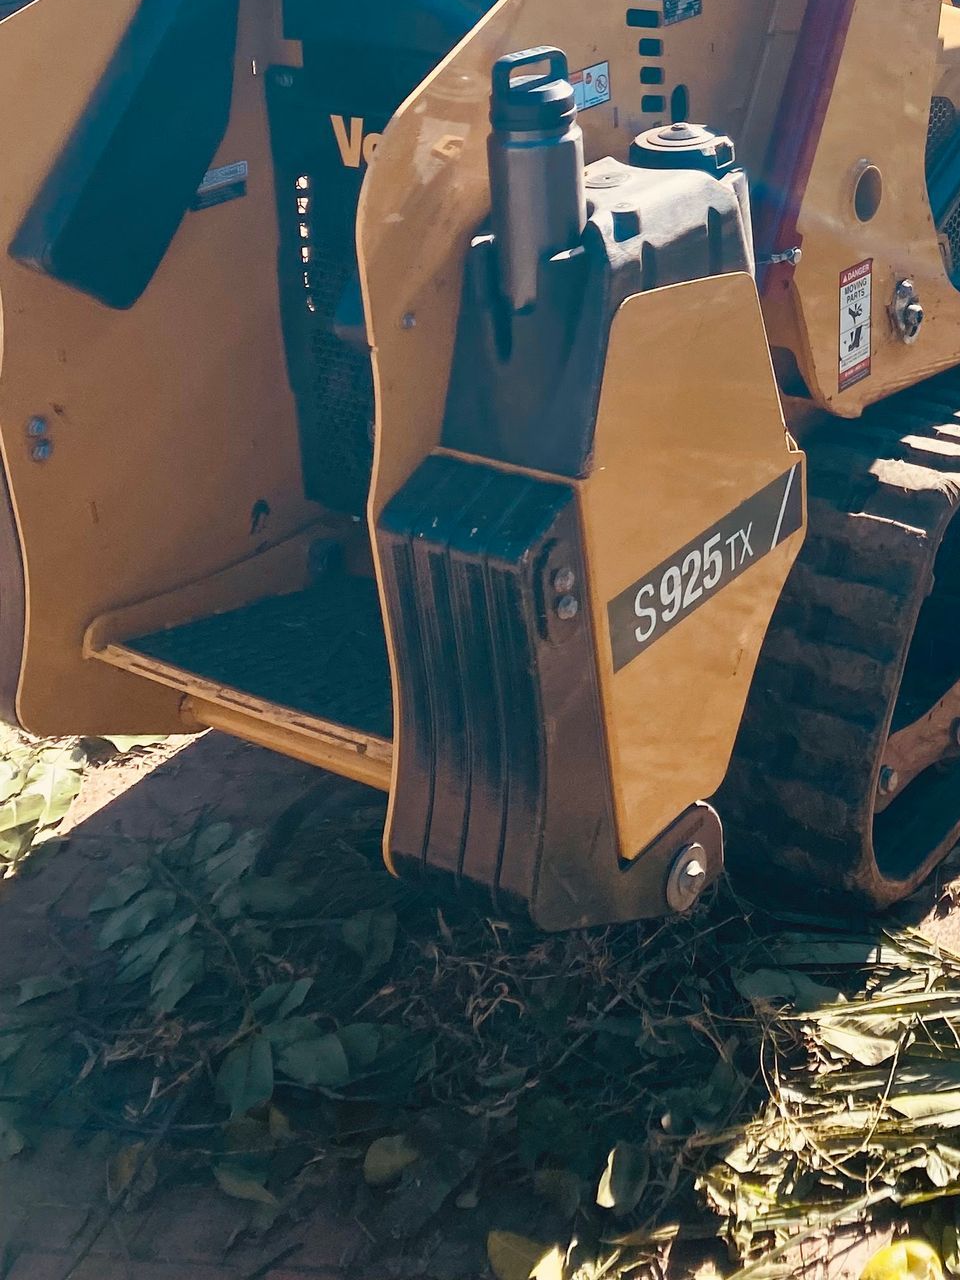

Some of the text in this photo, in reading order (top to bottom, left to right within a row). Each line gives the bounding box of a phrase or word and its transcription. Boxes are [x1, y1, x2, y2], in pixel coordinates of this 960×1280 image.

[848, 263, 870, 280] DANGER
[845, 277, 867, 295] MOVING
[846, 288, 865, 304] PARTS
